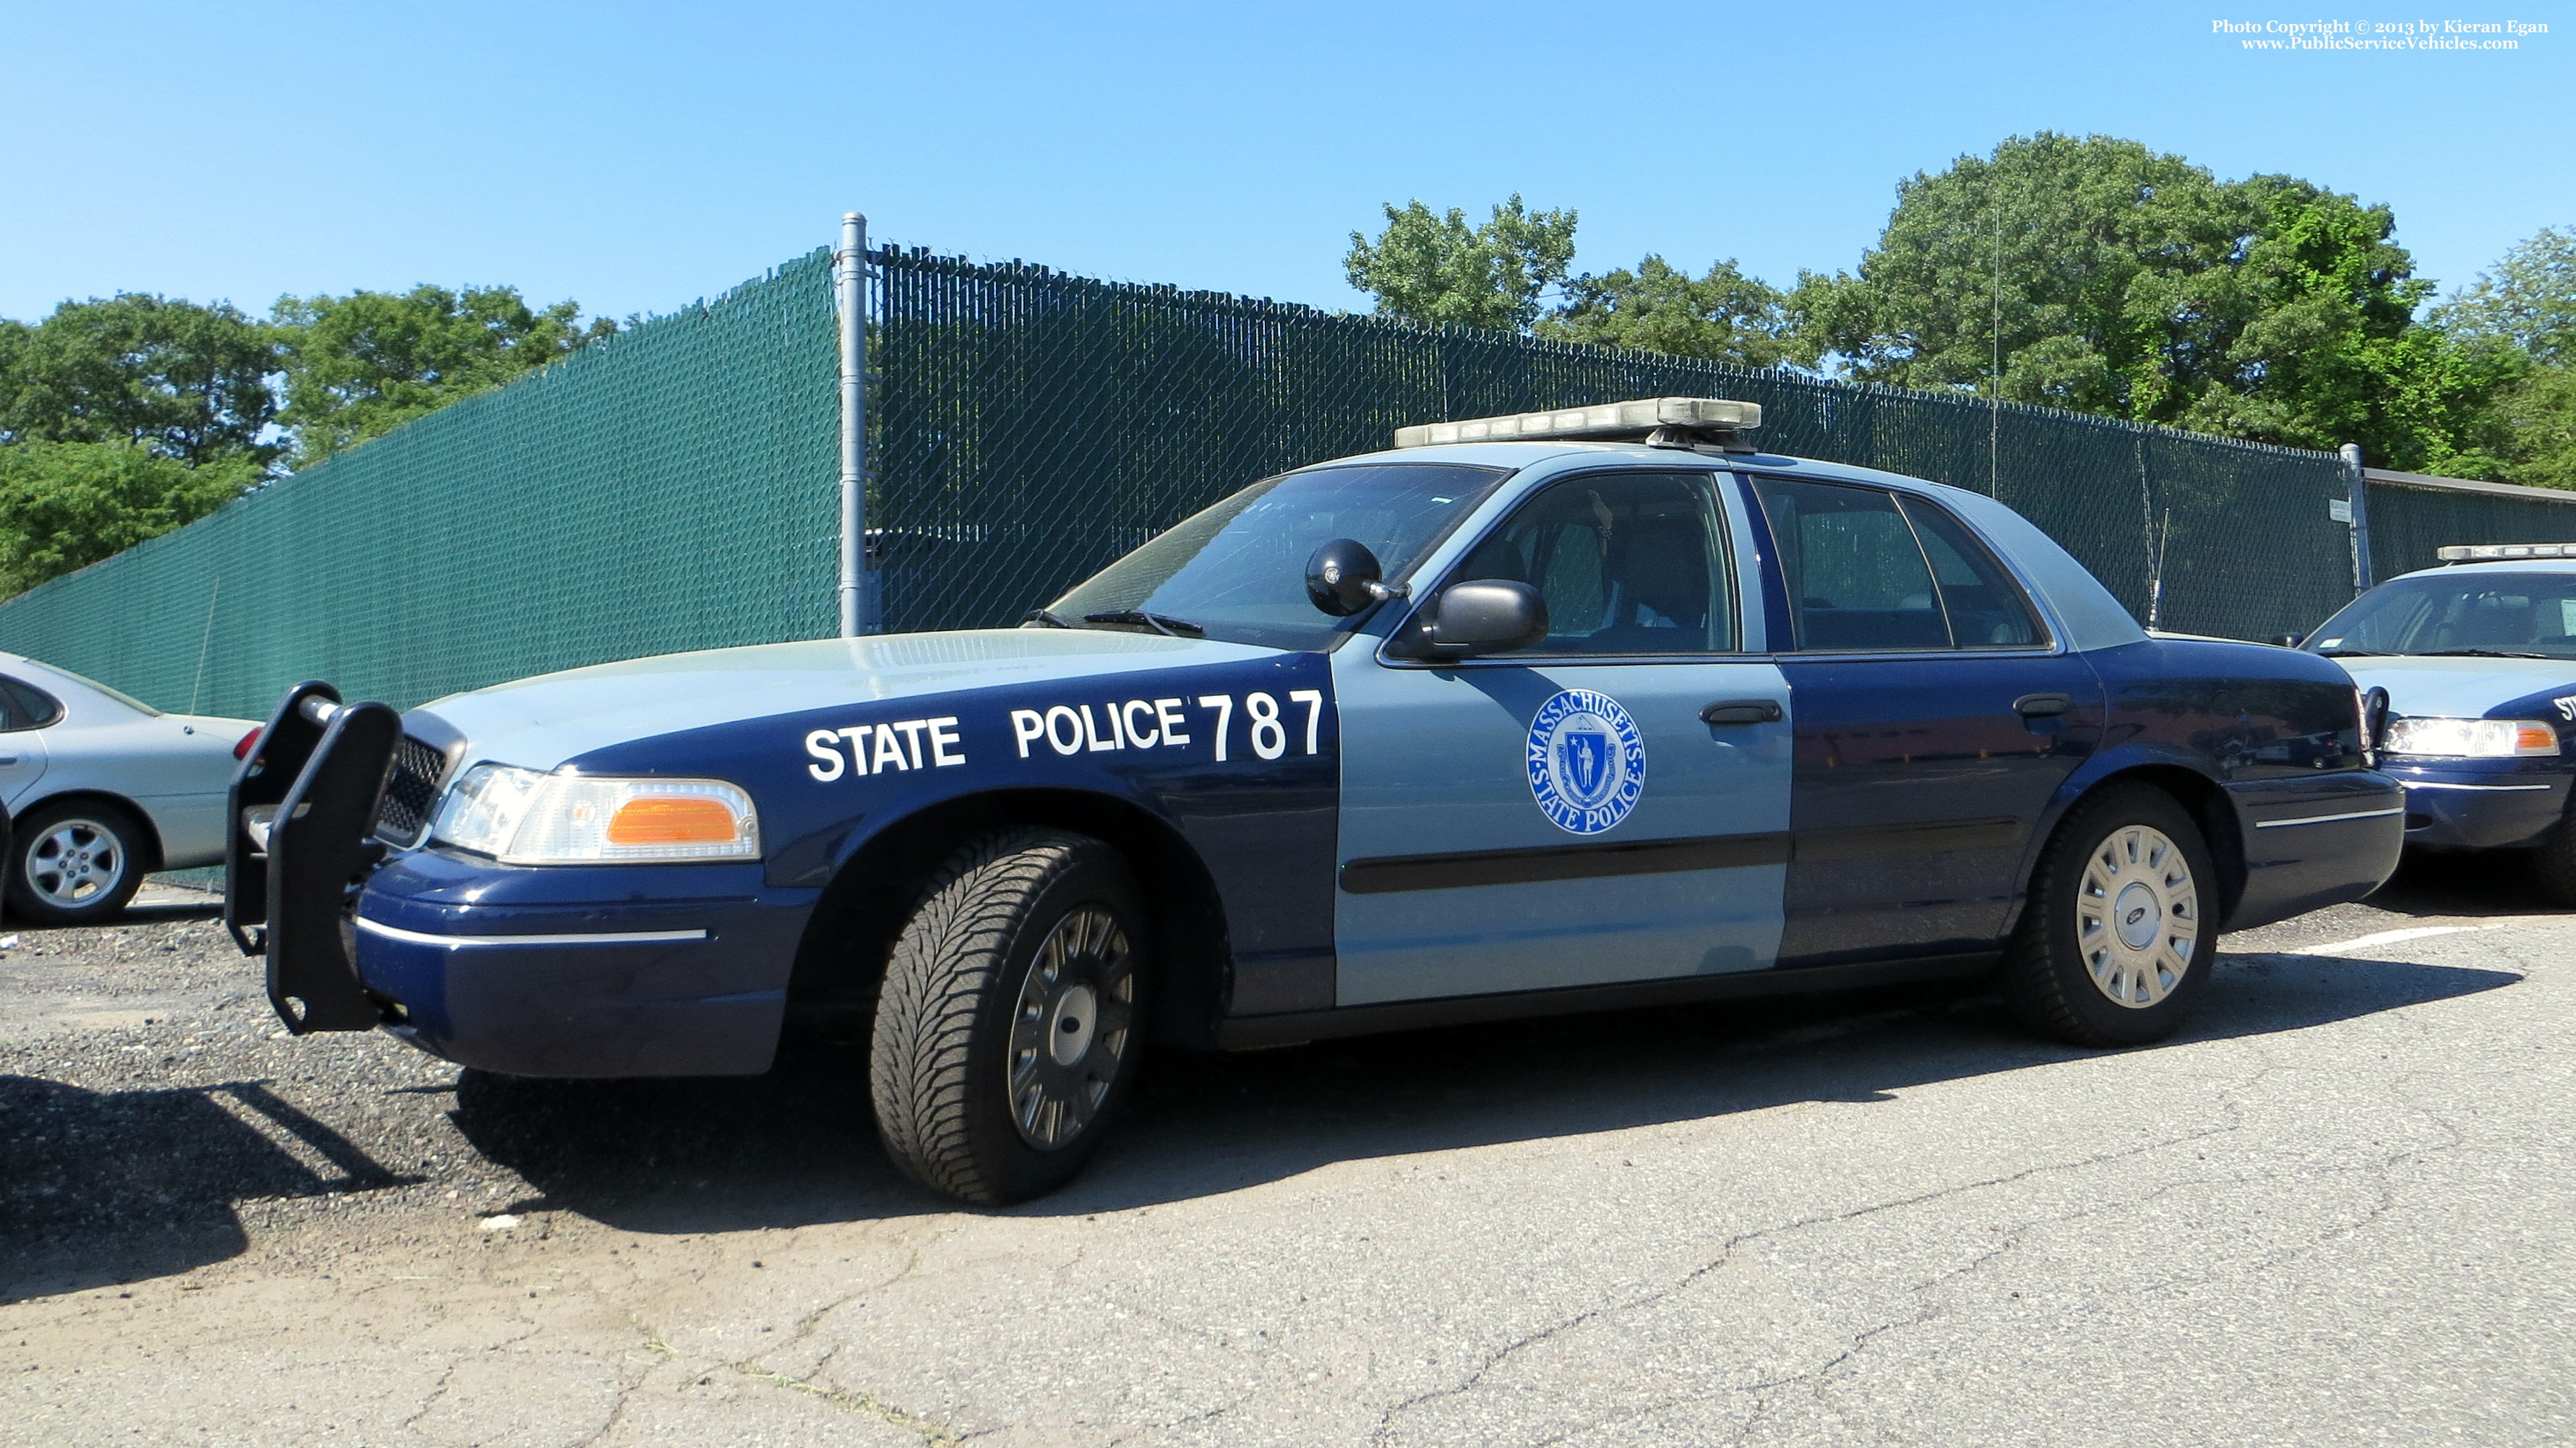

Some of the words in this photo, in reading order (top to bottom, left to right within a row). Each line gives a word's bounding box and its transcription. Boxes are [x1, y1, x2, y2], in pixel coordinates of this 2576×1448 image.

[806, 716, 965, 781] STATE
[1010, 698, 1190, 758] POLICE
[1199, 690, 1323, 761] 787
[1529, 692, 1642, 763] MASSACHUSETTS
[1532, 768, 1580, 830] STATE
[1585, 768, 1641, 831] POLICE
